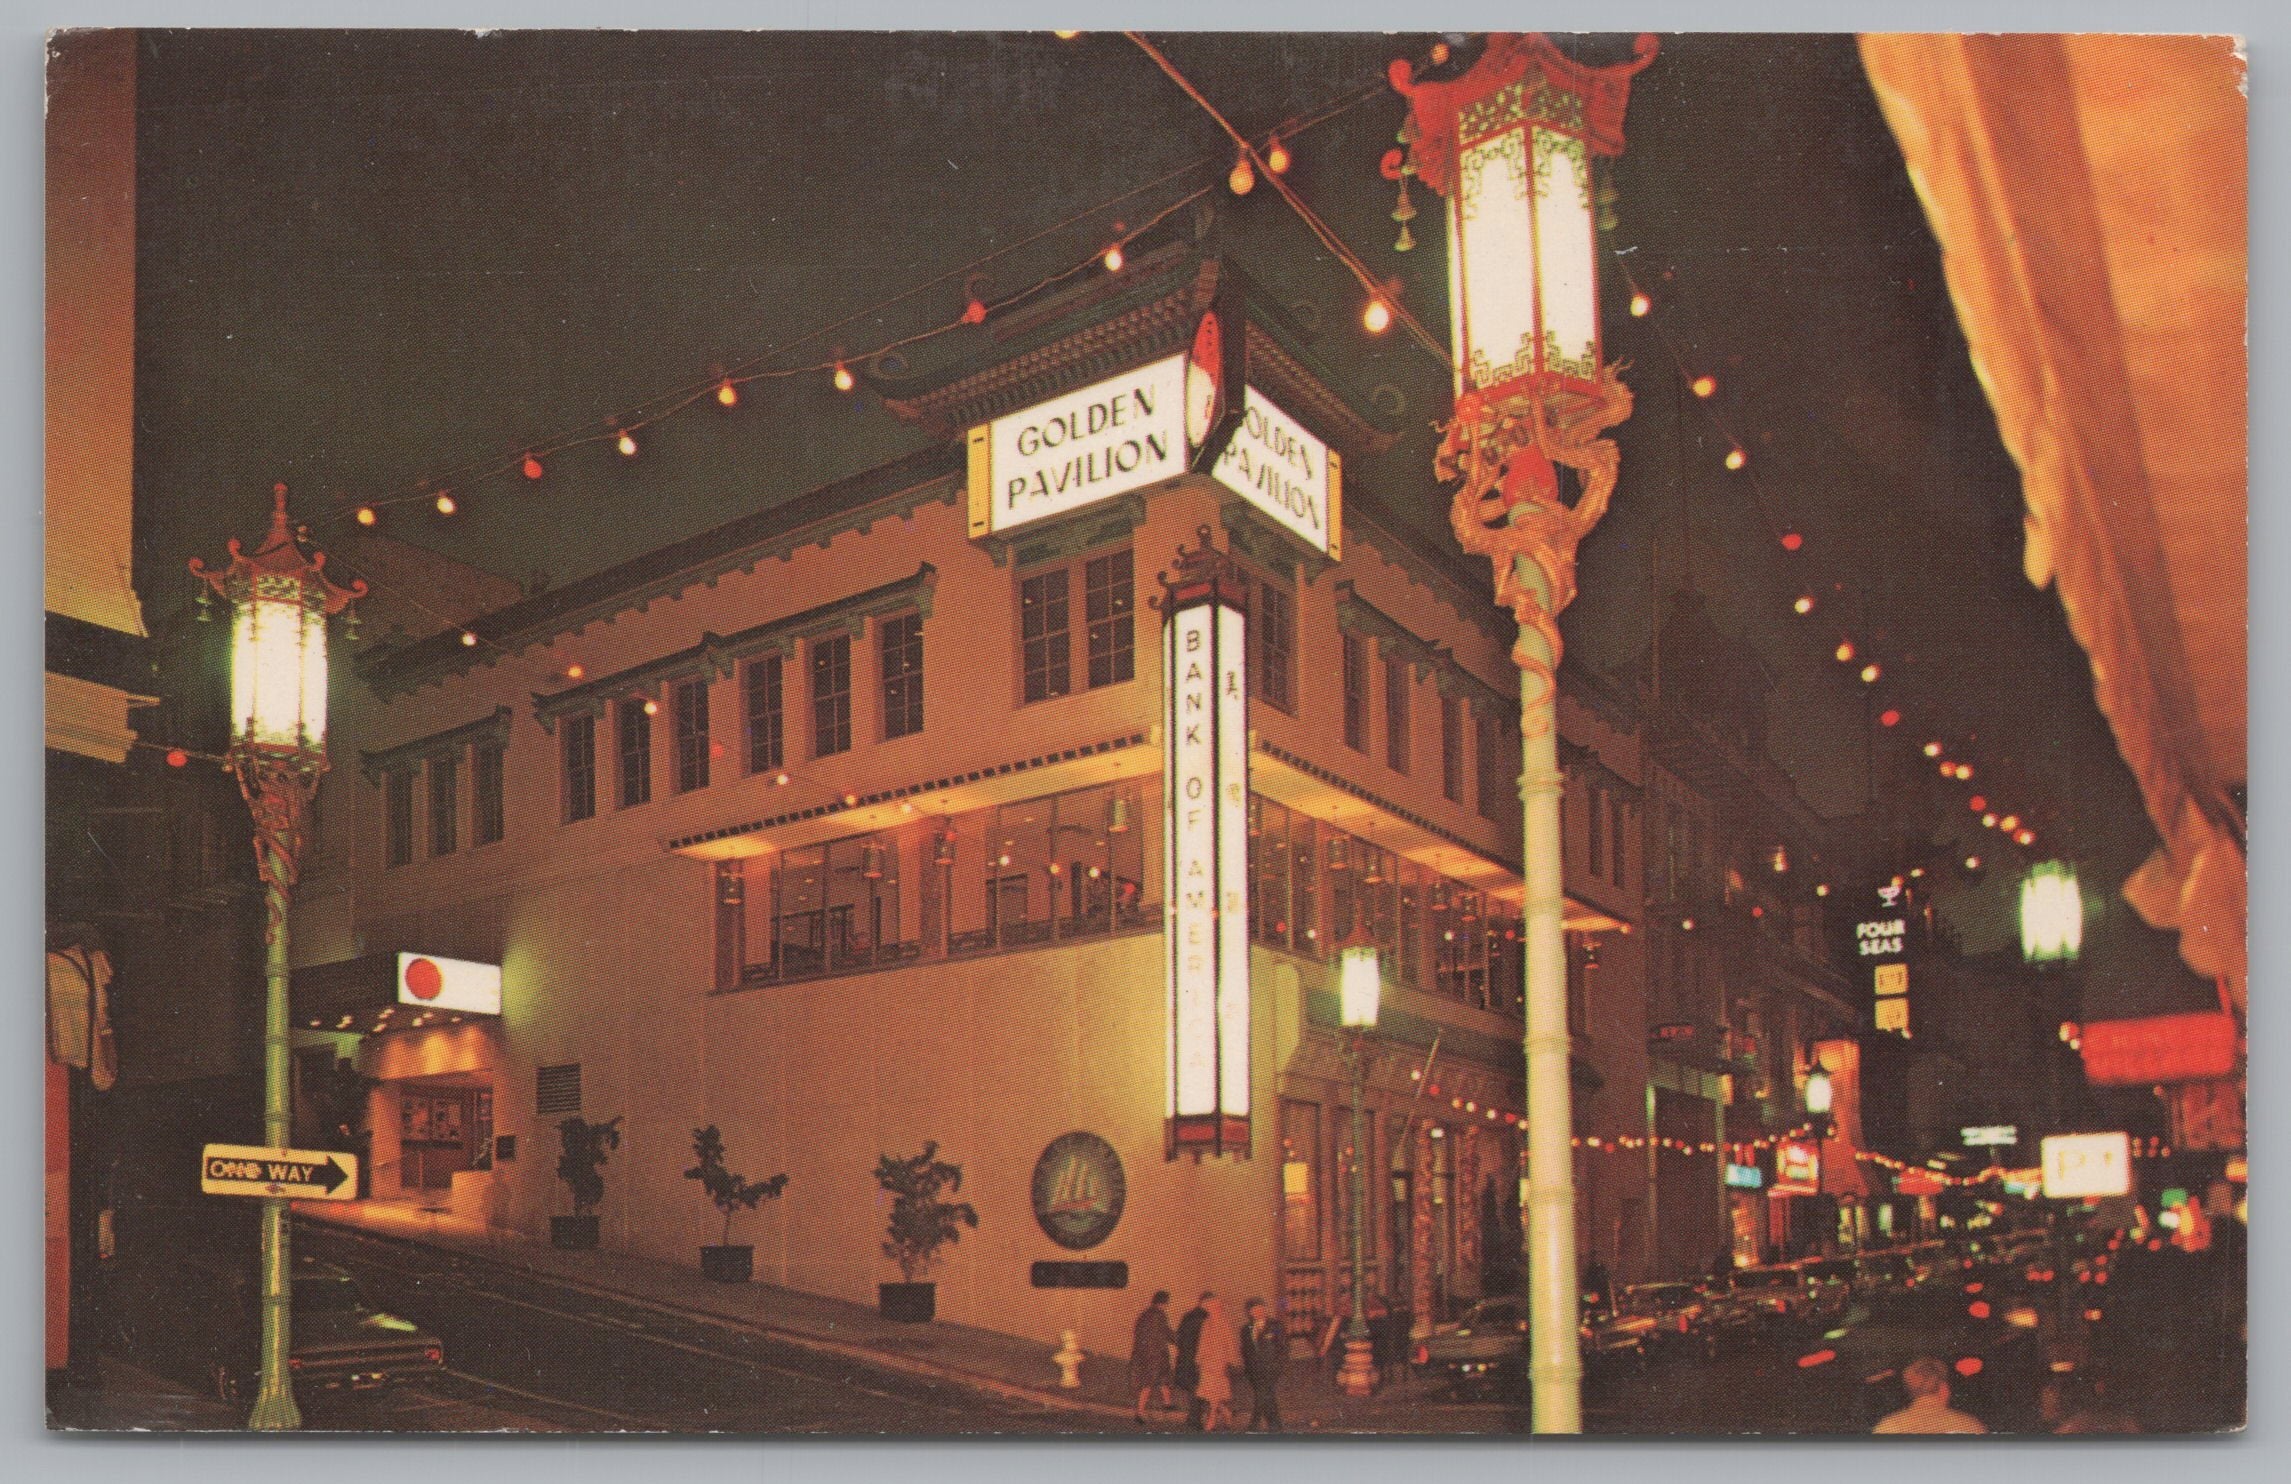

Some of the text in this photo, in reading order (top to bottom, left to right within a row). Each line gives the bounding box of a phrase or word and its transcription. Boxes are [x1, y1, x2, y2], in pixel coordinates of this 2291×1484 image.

[1017, 384, 1155, 457] GOLDEN
[1246, 406, 1313, 480] OLDEN
[1008, 430, 1167, 510] PAVILION
[1186, 629, 1203, 745] BANK
[1186, 776, 1203, 832] OF
[1856, 919, 1906, 939] FOUR
[1858, 937, 1904, 956] SEAS
[210, 1160, 314, 1182] ONE WAY
